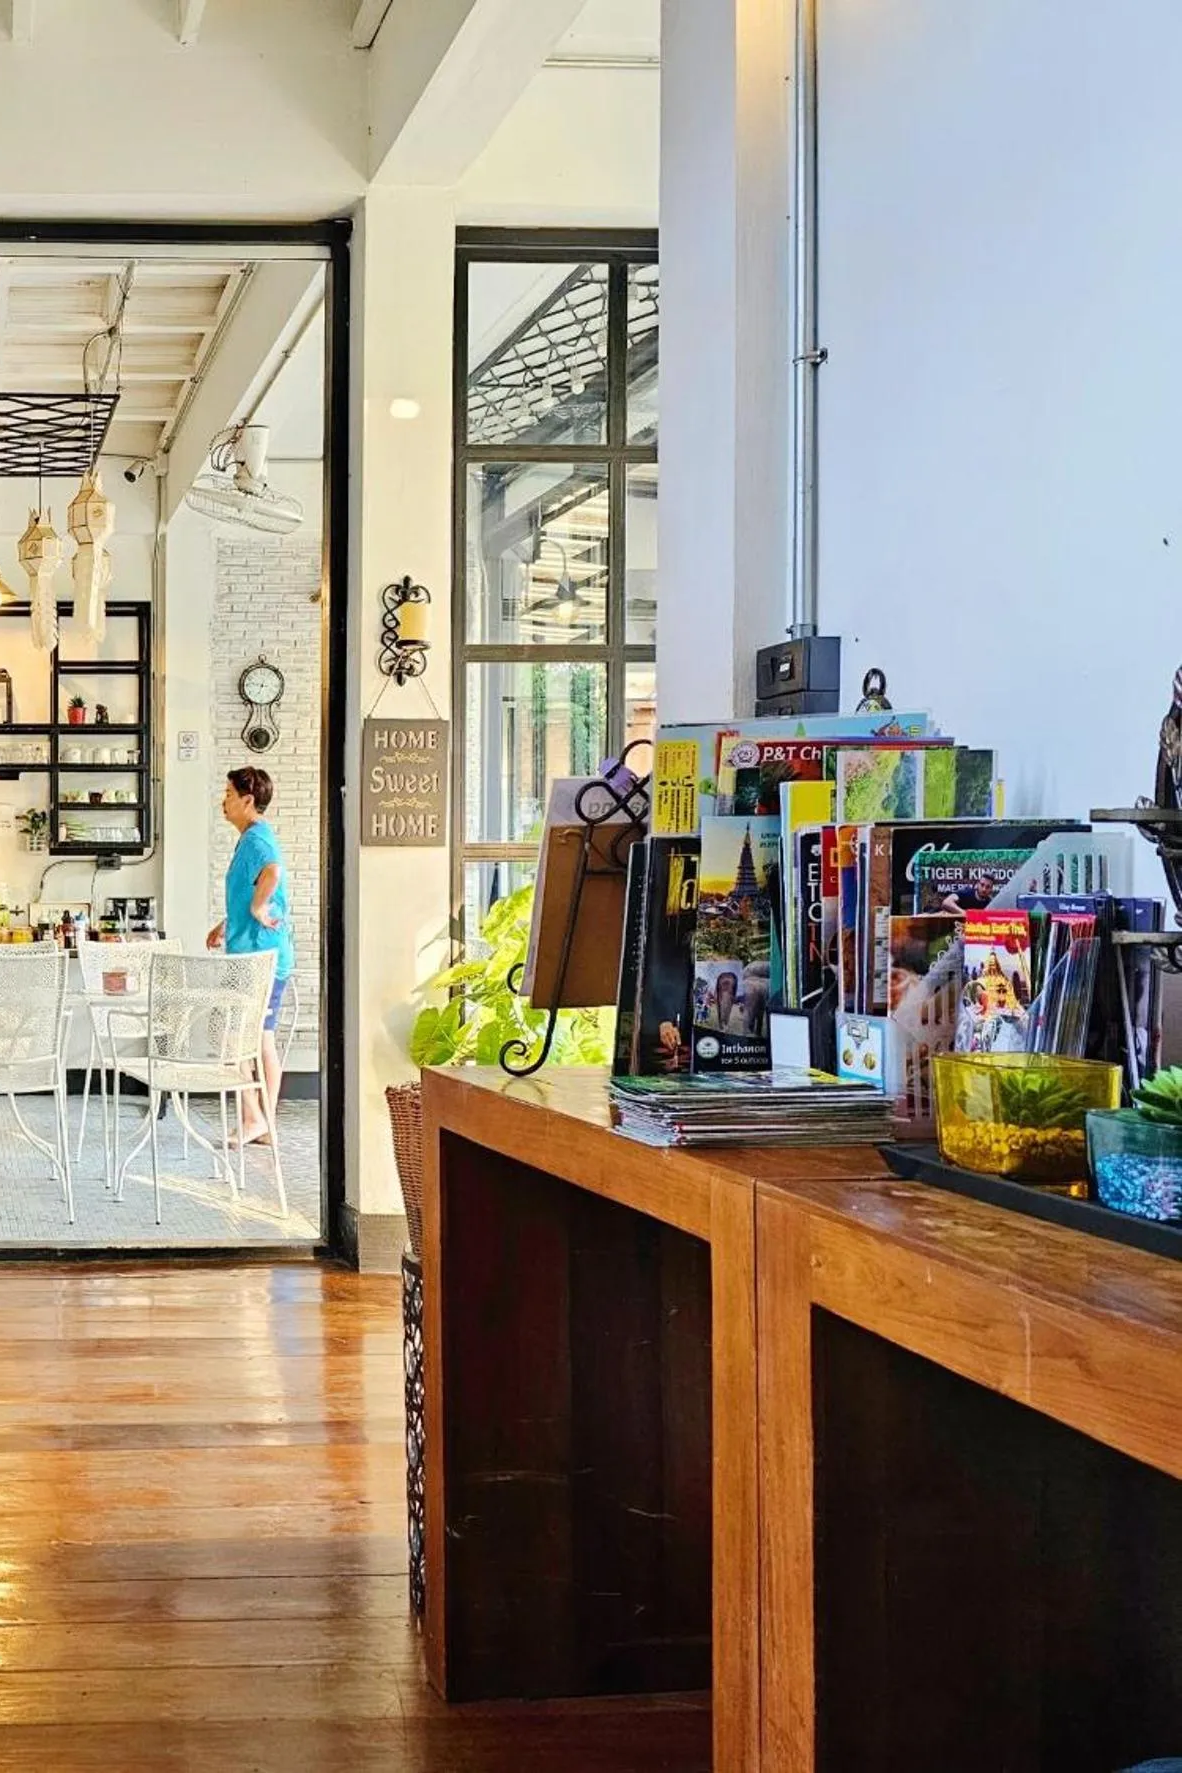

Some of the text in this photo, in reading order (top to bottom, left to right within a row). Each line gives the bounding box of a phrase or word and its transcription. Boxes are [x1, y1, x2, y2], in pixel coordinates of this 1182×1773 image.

[374, 730, 439, 749] HOME
[762, 746, 797, 762] P&T
[369, 766, 440, 793] Sweet
[371, 813, 439, 837] HOME
[921, 867, 1015, 880] TIGER KINGDO
[721, 1042, 767, 1054] Inthanon
